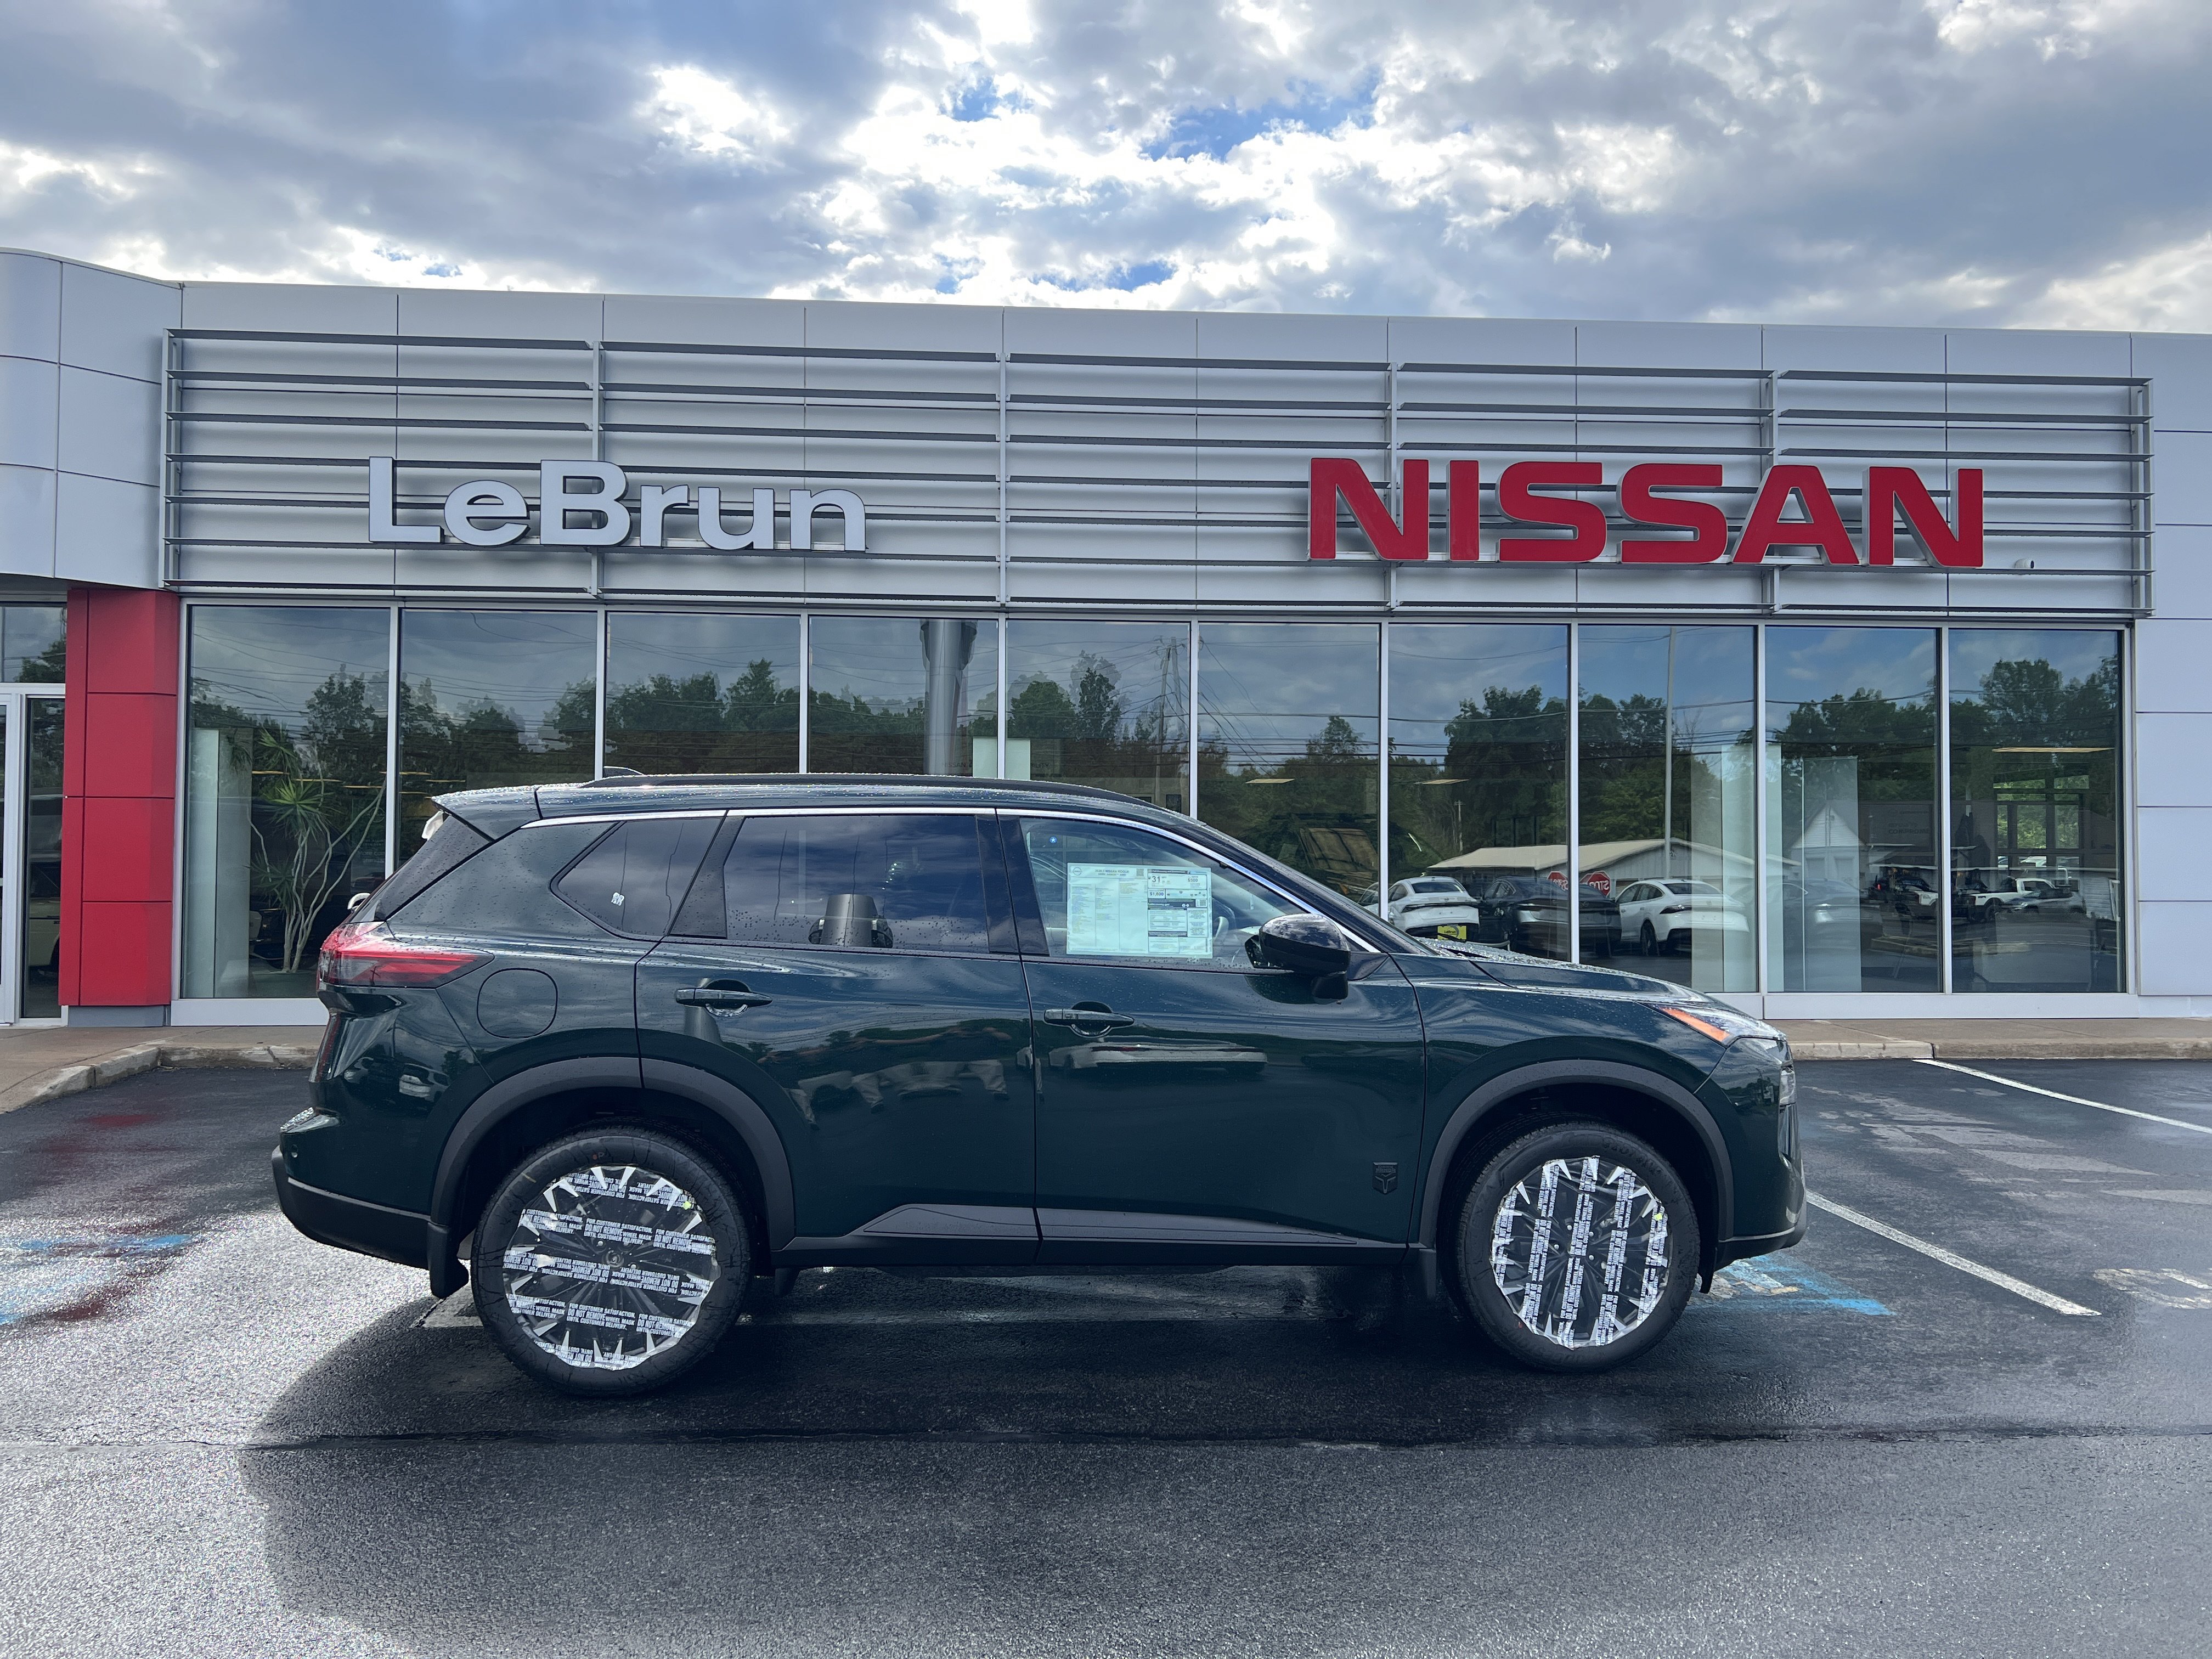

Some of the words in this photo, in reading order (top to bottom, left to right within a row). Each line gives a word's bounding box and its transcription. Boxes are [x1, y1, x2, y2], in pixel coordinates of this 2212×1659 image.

[368, 456, 867, 553] LeBrun
[1308, 457, 1984, 569] NISSAN
[596, 1219, 620, 1228] CUSTOMER
[592, 1224, 602, 1233] NOT
[603, 1226, 623, 1236] REMOVE
[1577, 1220, 1585, 1238] REMOVE
[597, 1232, 622, 1242] CUSTOMER
[1536, 1236, 1544, 1255] REMOVE
[1611, 1247, 1620, 1266] REMOVE
[641, 1270, 666, 1279] CUSTOMER
[640, 1276, 660, 1285] REMOVE
[642, 1283, 667, 1292] CUSTOMER
[1567, 1284, 1576, 1302] REMOVE
[579, 1304, 603, 1313] CUSTOMER
[585, 1311, 606, 1321] REMOVE
[580, 1317, 605, 1326] CUSTOMER
